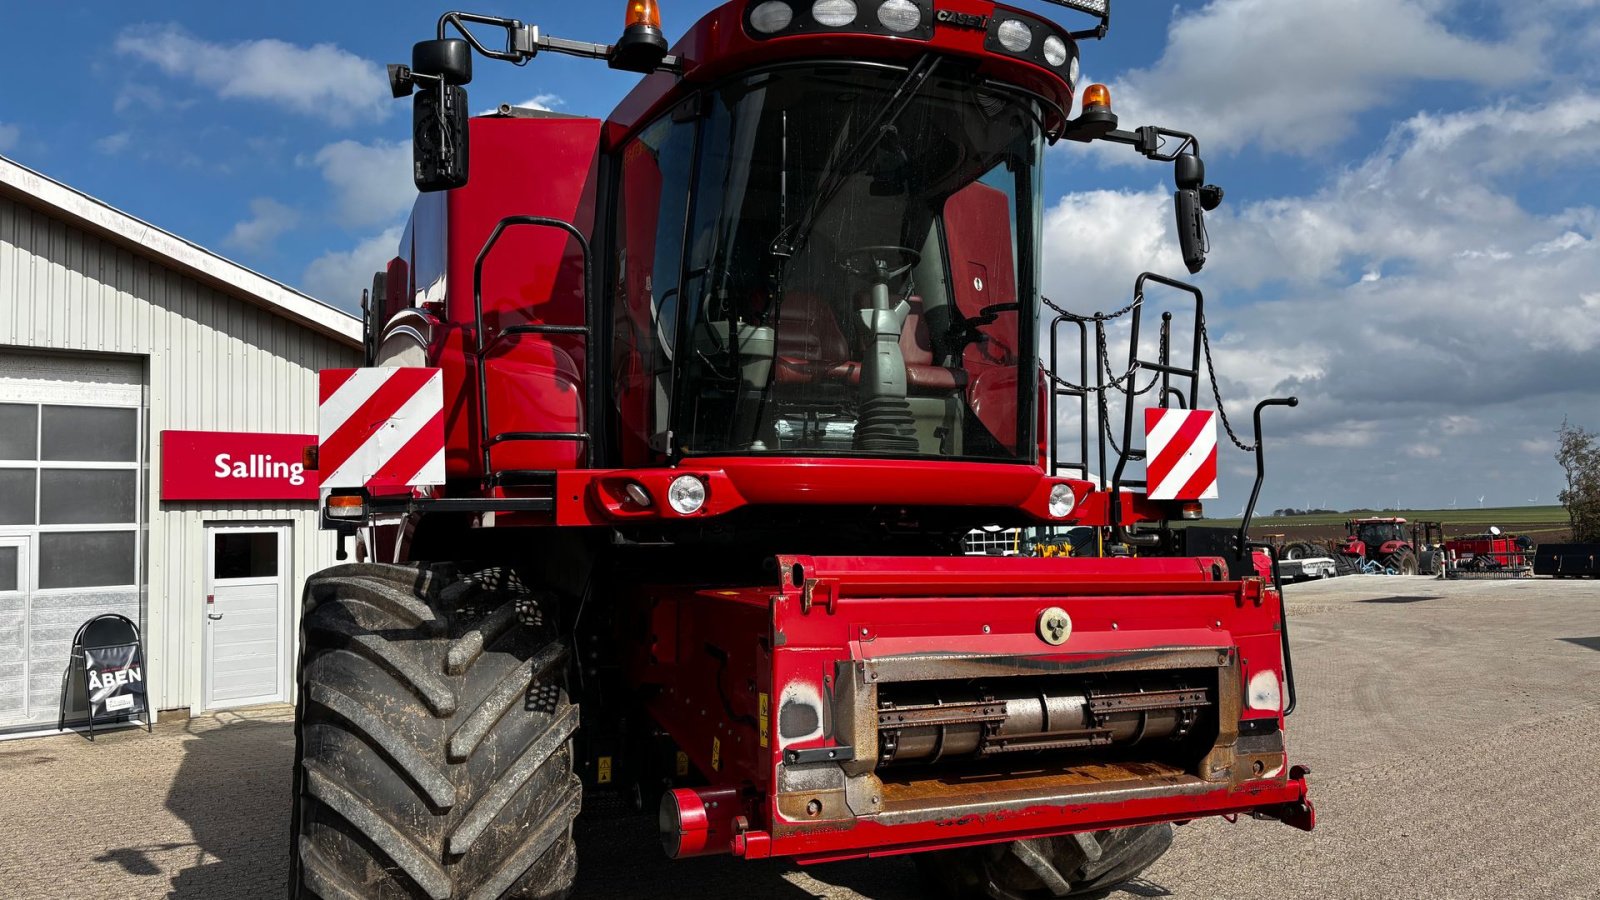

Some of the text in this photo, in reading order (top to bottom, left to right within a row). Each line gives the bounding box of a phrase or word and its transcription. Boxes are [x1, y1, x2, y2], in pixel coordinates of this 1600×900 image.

[936, 10, 976, 26] CASE
[214, 453, 305, 486] Salling
[88, 667, 142, 691] ÅBEN
